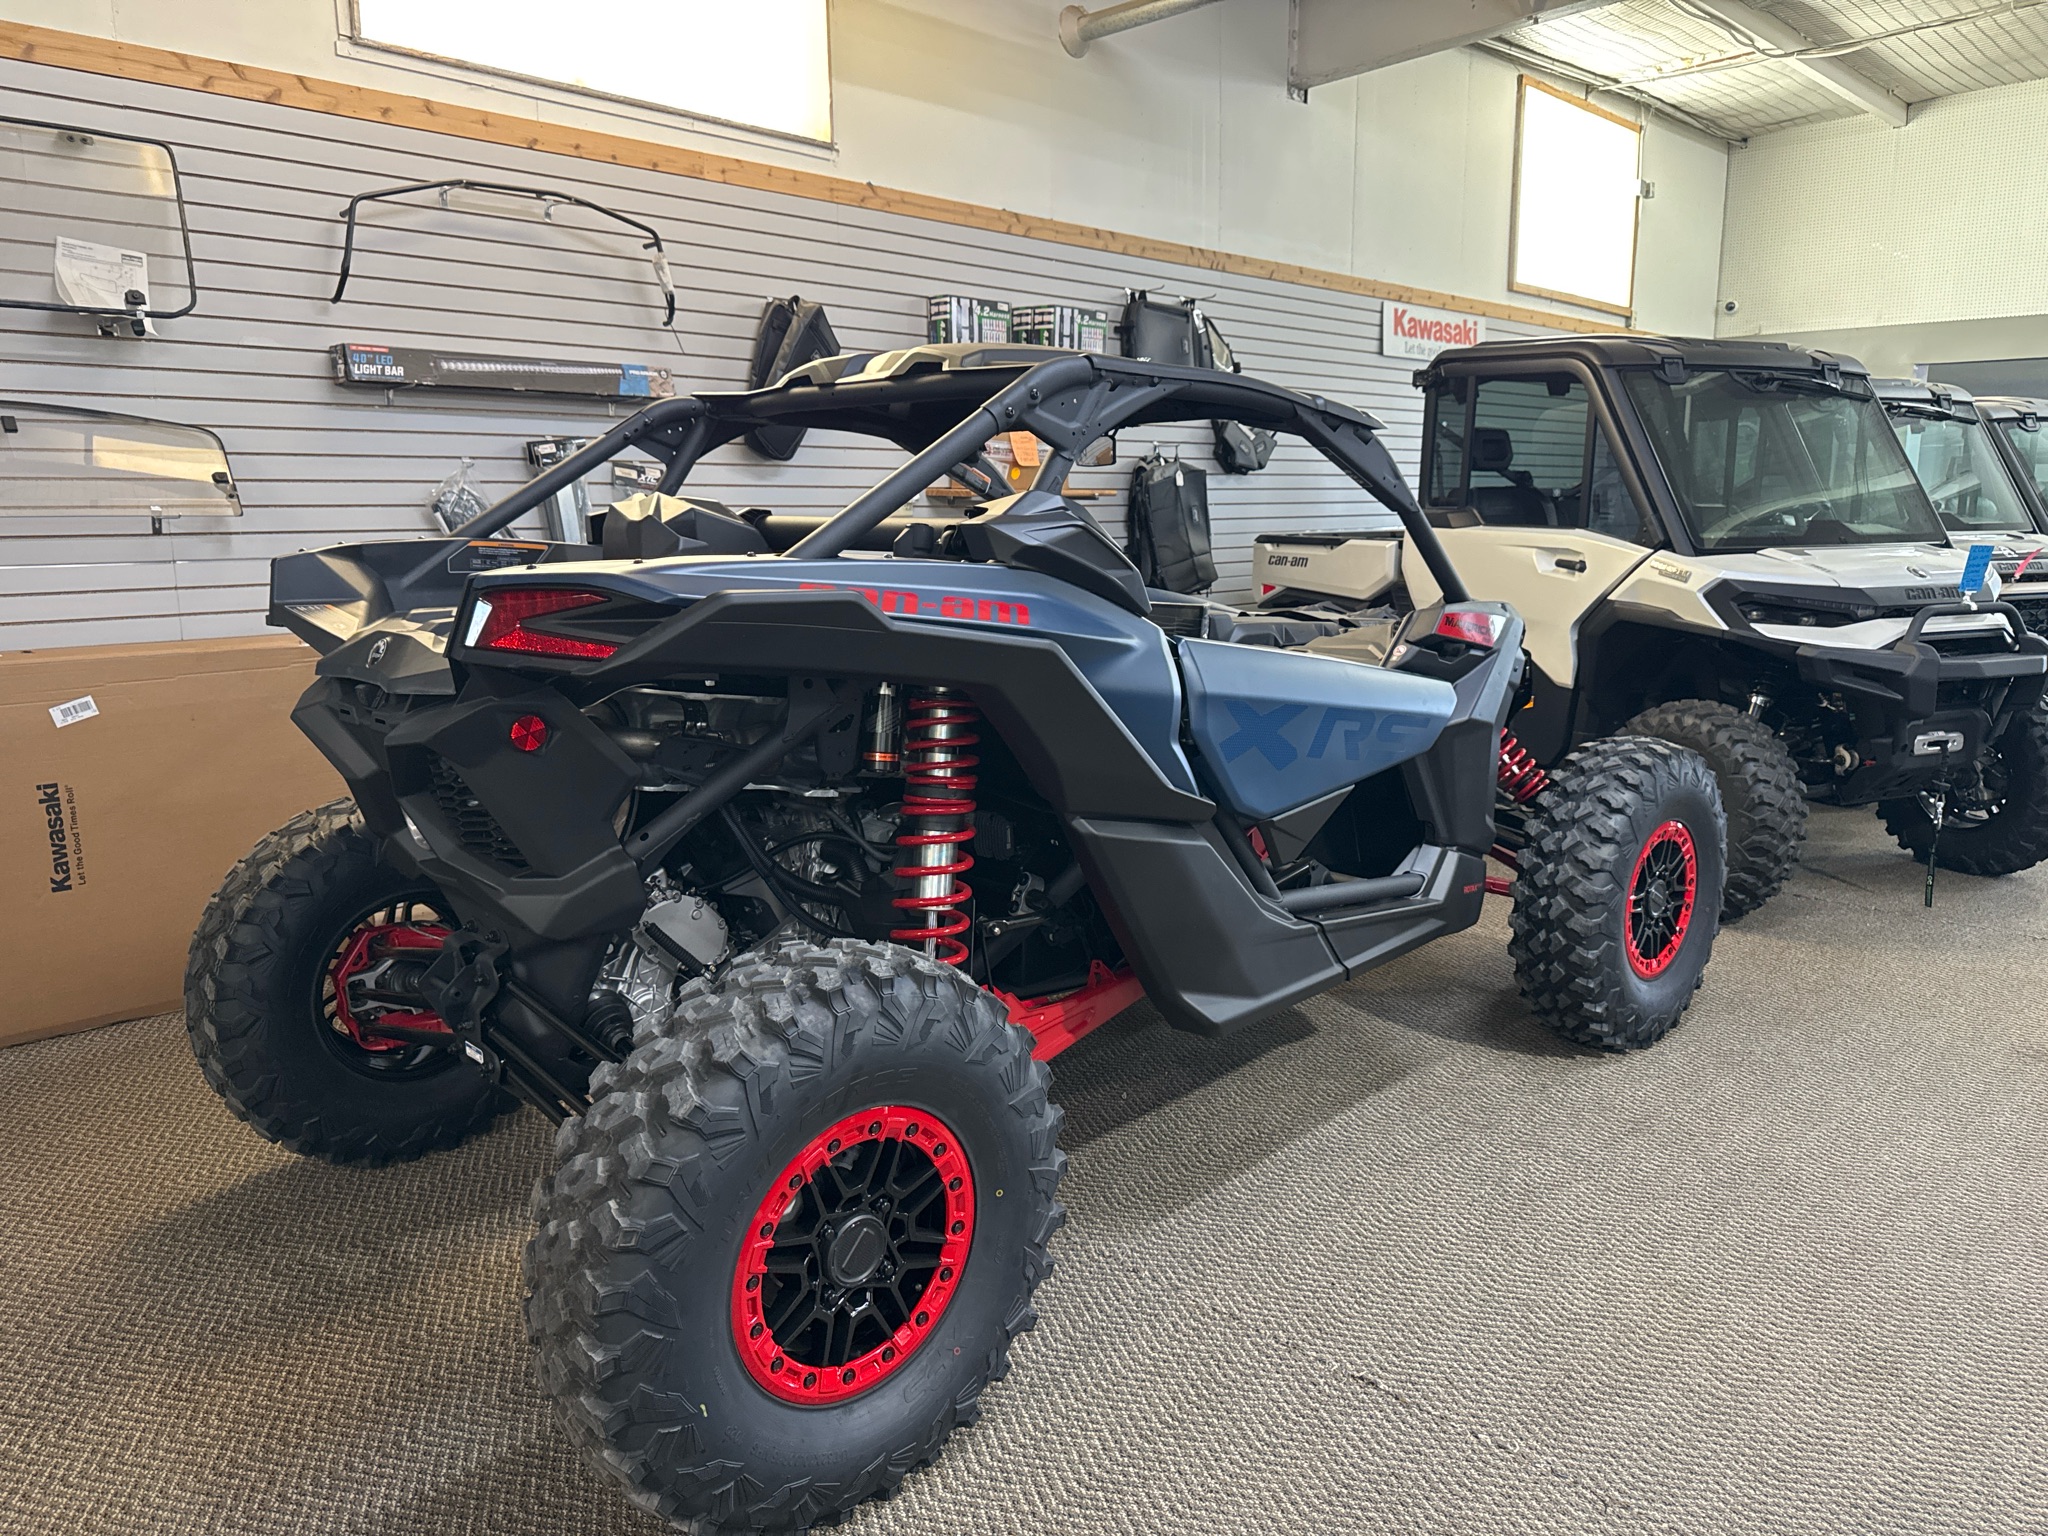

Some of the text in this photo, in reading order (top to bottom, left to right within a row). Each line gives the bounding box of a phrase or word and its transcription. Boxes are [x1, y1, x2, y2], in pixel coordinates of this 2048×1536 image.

[975, 304, 990, 316] 4.2
[1393, 307, 1478, 346] Kawasaki
[1404, 341, 1415, 354] Let
[354, 363, 405, 377] LIGHT BAR
[1267, 554, 1309, 569] can-am
[69, 806, 78, 832] Times
[36, 783, 72, 892] Kawasaki
[72, 832, 82, 855] Good
[75, 856, 84, 871] the
[77, 872, 86, 886] Let
